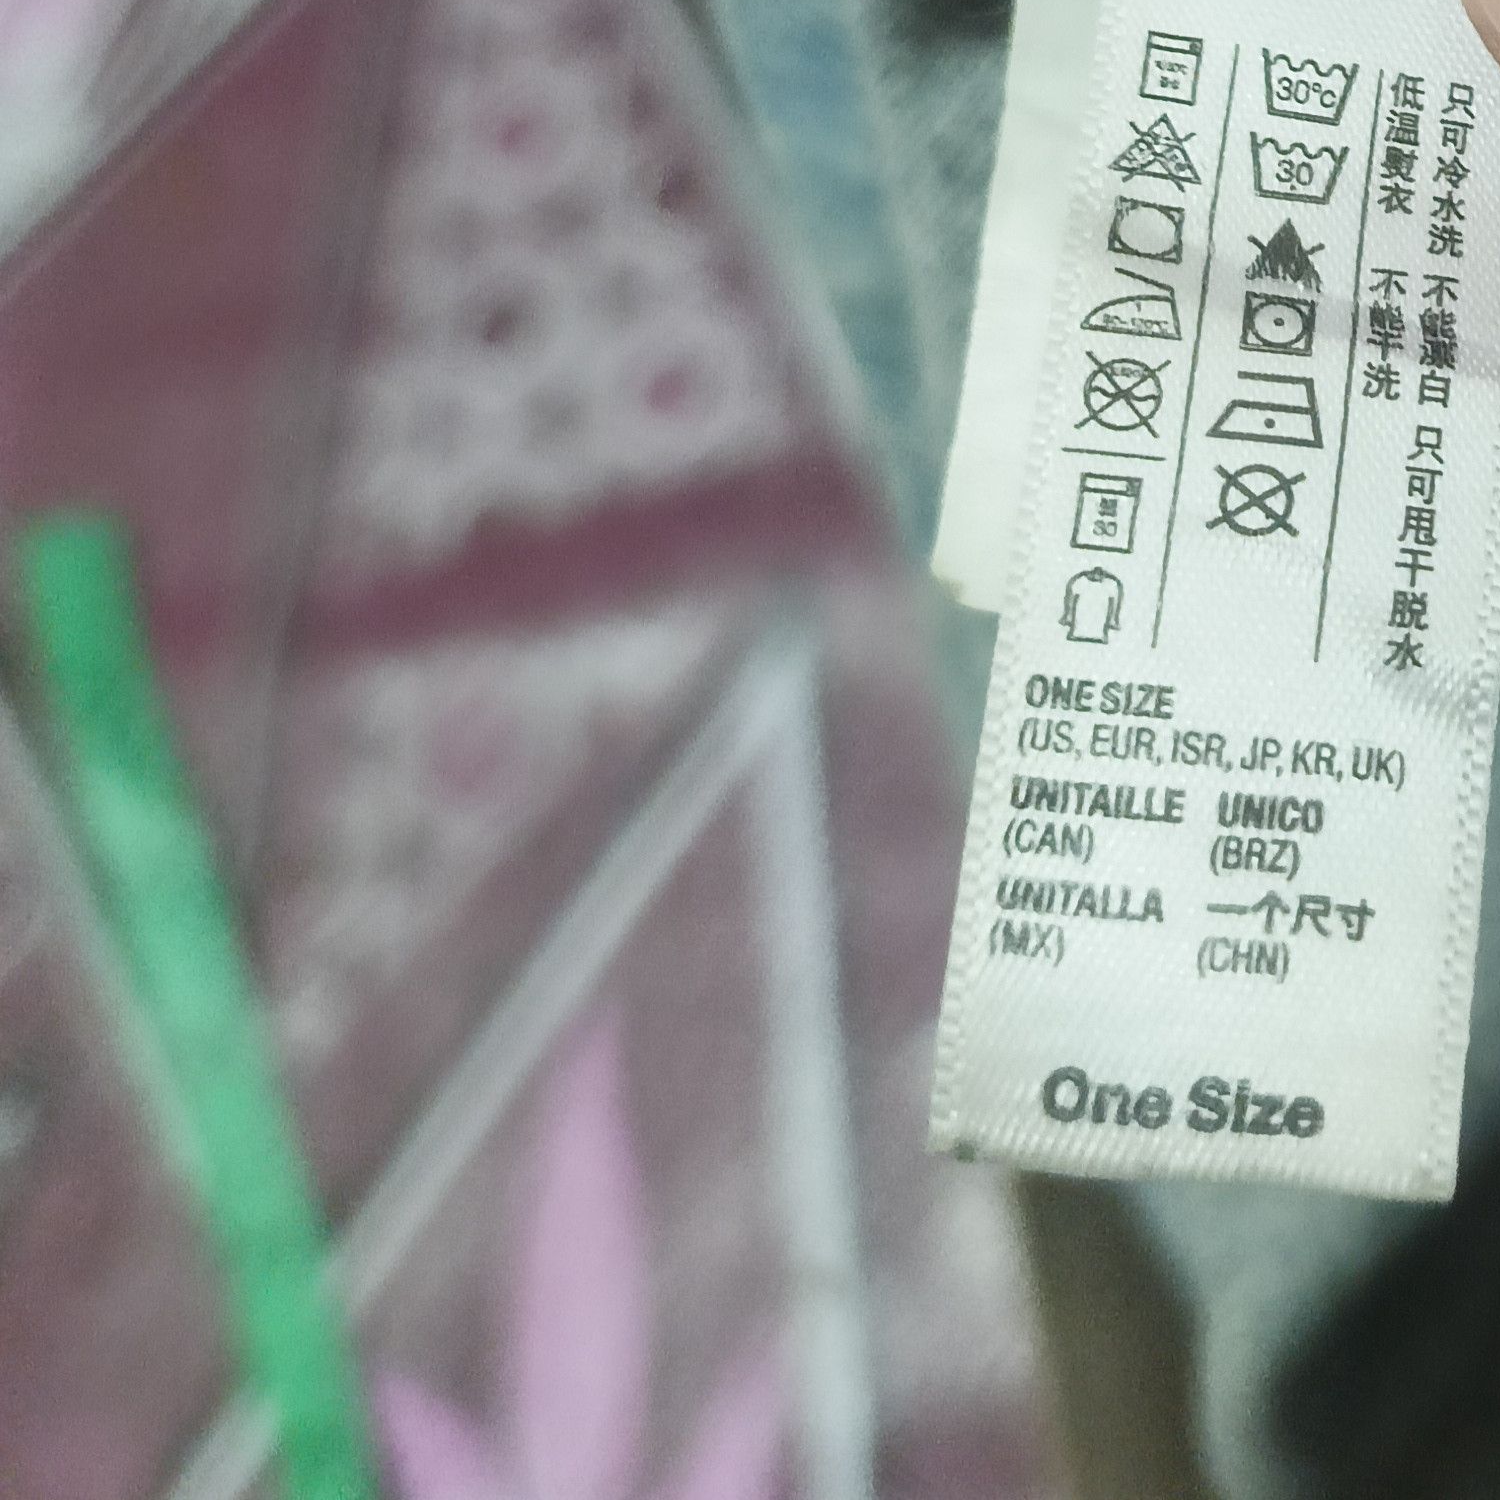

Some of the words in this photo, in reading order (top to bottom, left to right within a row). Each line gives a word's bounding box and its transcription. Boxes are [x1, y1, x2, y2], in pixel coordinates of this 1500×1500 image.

[1275, 158, 1314, 187] 30
[1024, 673, 1096, 713] ONE
[1099, 682, 1176, 719] SIZE
[1018, 717, 1084, 760] (US,
[1089, 723, 1162, 766] EUR,
[1170, 729, 1232, 773] ISR,
[1240, 735, 1284, 777] JP,
[1290, 739, 1343, 784] KR,
[1350, 742, 1406, 793] UK)
[1009, 773, 1186, 824] UNITAILLE
[1217, 789, 1325, 835] UNICO
[1003, 817, 1095, 865] (CAN)
[1209, 834, 1301, 881] (BRZ)
[996, 874, 1165, 923] UNITALLA
[1205, 889, 1376, 942] 一个尺寸
[988, 918, 1065, 968] (MX)
[1197, 935, 1291, 984] (CHN)
[1041, 1064, 1173, 1131] One
[1186, 1073, 1325, 1140] Size
